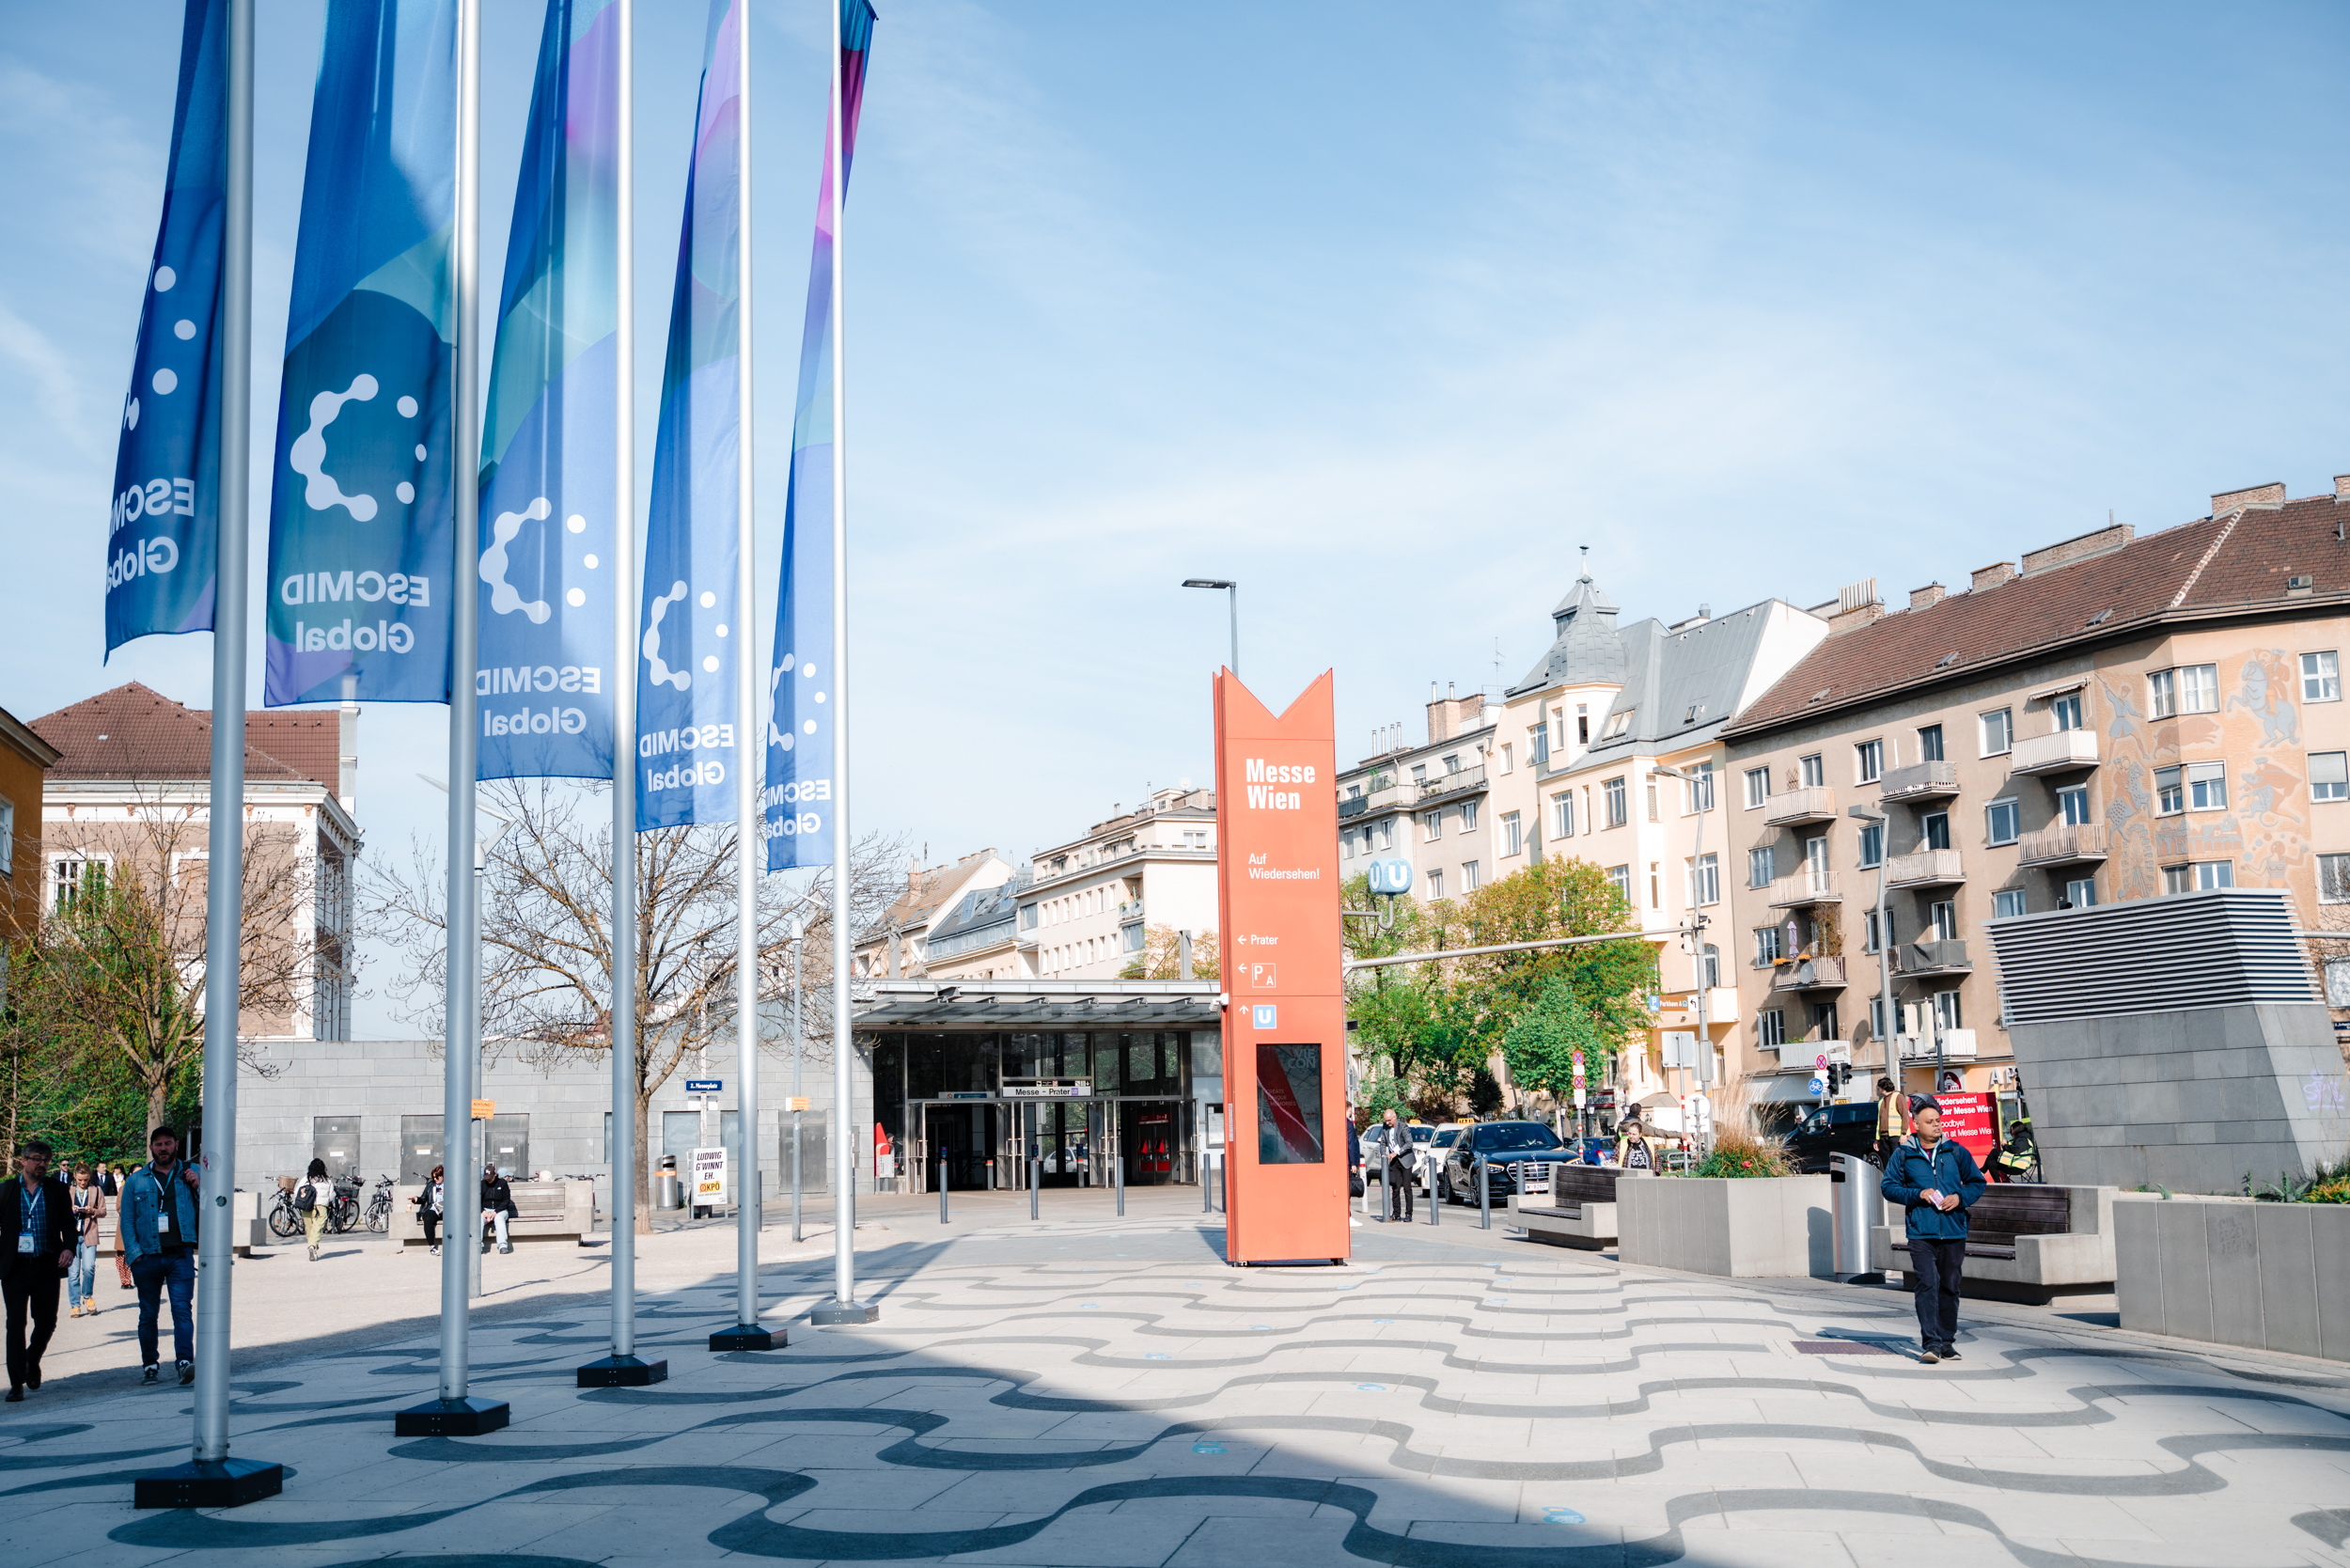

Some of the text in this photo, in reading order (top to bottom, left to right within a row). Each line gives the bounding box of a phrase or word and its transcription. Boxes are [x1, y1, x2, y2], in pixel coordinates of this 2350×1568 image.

[1246, 758, 1316, 783] Messe
[1246, 785, 1301, 809] Wien
[1248, 853, 1267, 865] Auf
[1248, 868, 1321, 880] Wiedersehen!
[1388, 865, 1408, 888] U
[1250, 934, 1279, 946] Prater
[1253, 964, 1275, 986] P A
[1258, 1009, 1272, 1025] U
[1288, 1058, 1316, 1069] CON
[1953, 1106, 1976, 1115] Messe
[1976, 1105, 1994, 1114] Wien
[1941, 1119, 1966, 1129] oodbye!
[1957, 1128, 1979, 1137] Messe
[1979, 1127, 1995, 1136] Wien
[697, 1151, 723, 1161] LUDWIG
[696, 1161, 724, 1171] G'WINNT
[704, 1171, 715, 1181] EH.
